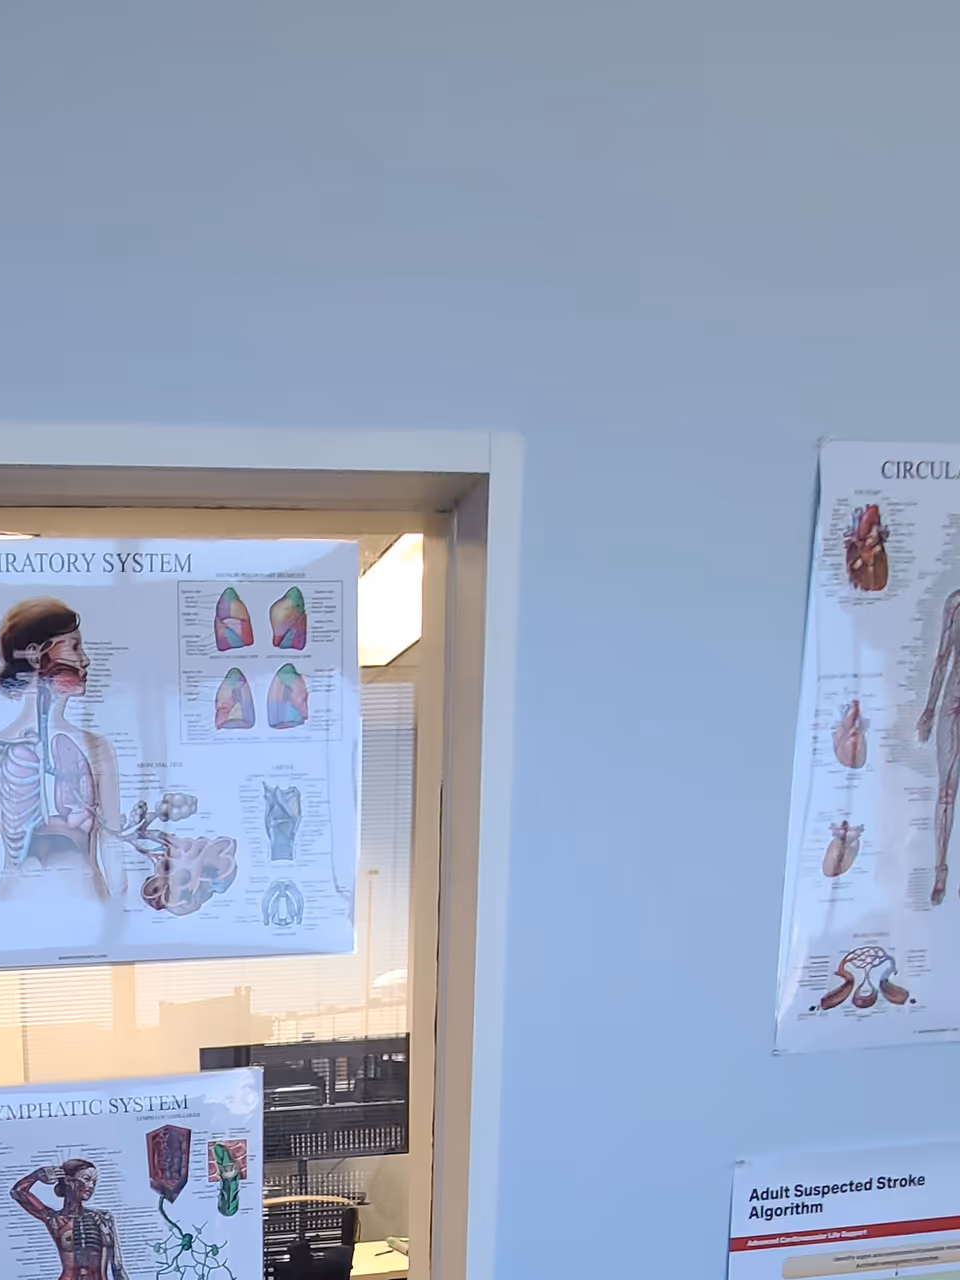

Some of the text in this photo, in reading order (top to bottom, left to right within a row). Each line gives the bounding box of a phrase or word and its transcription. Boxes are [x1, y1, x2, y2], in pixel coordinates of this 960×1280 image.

[102, 552, 193, 574] SYSTEM
[108, 1094, 190, 1116] SYSTEM
[749, 1174, 926, 1202] Adult Suspected Stroke
[749, 1202, 823, 1221] Algorithm
